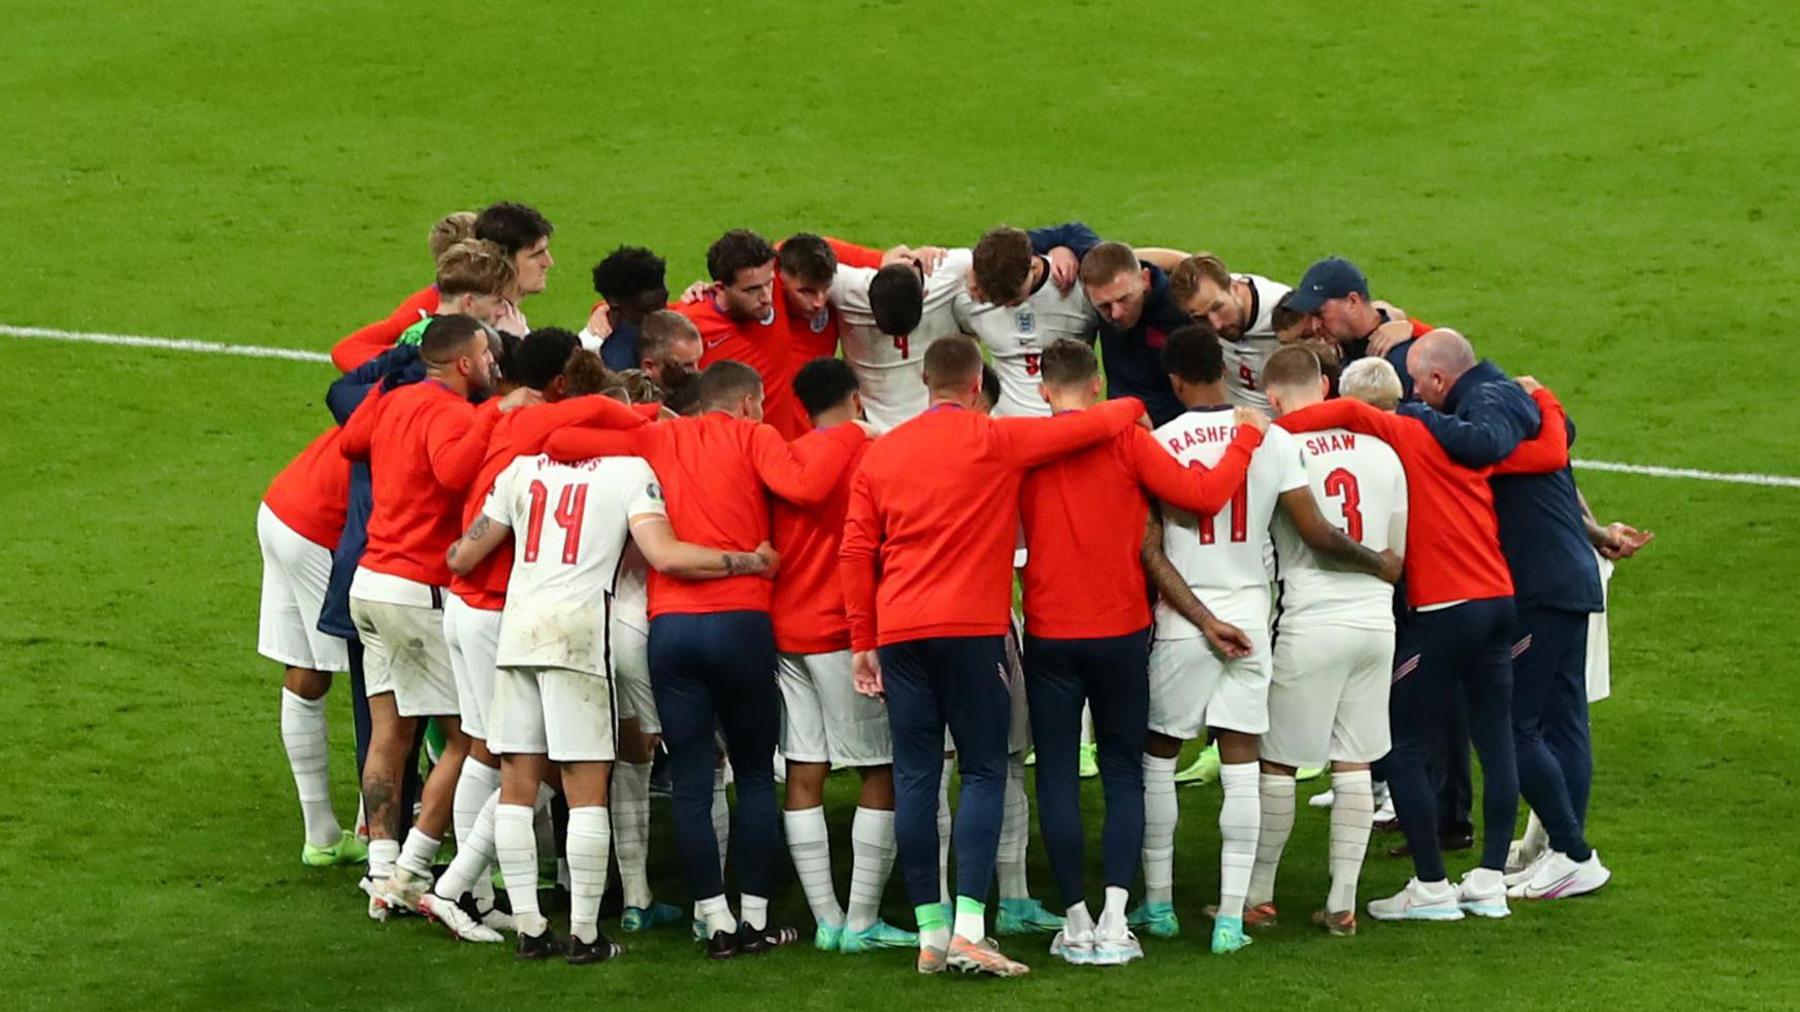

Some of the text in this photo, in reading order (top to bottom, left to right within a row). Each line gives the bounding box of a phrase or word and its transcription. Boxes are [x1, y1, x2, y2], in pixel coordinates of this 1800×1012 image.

[1306, 433, 1356, 456] SHAW
[524, 479, 590, 565] 14
[1324, 467, 1364, 543] 3
